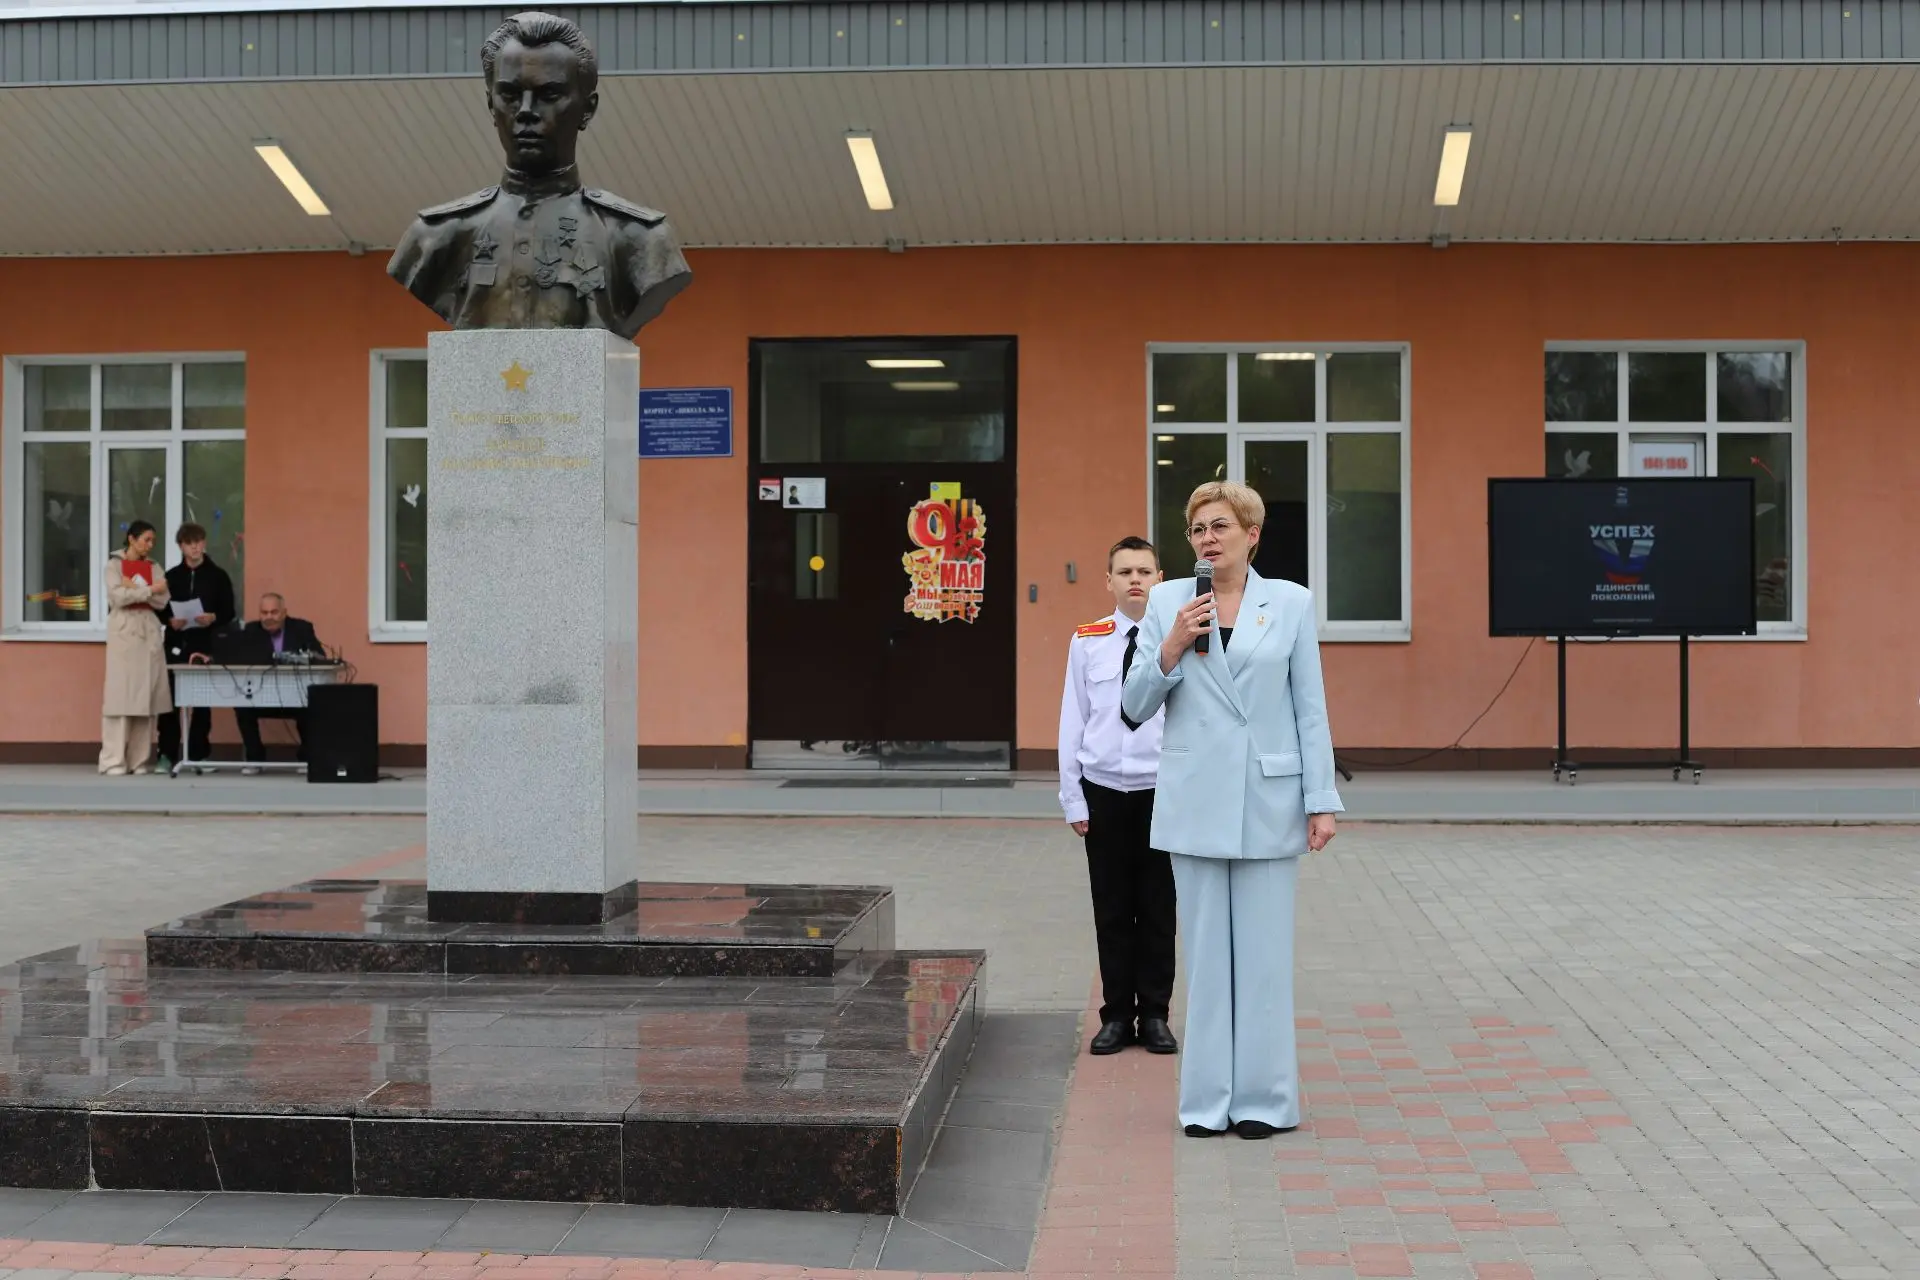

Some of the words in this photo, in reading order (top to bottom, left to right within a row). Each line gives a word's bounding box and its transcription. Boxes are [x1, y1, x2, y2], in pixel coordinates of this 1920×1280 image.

[1589, 525, 1655, 538] УСПЕХ
[940, 562, 983, 588] МАЯ
[1596, 584, 1650, 592] ЕДИНСТВЕ
[1591, 592, 1655, 601] ПОКОЛЕНИЙ
